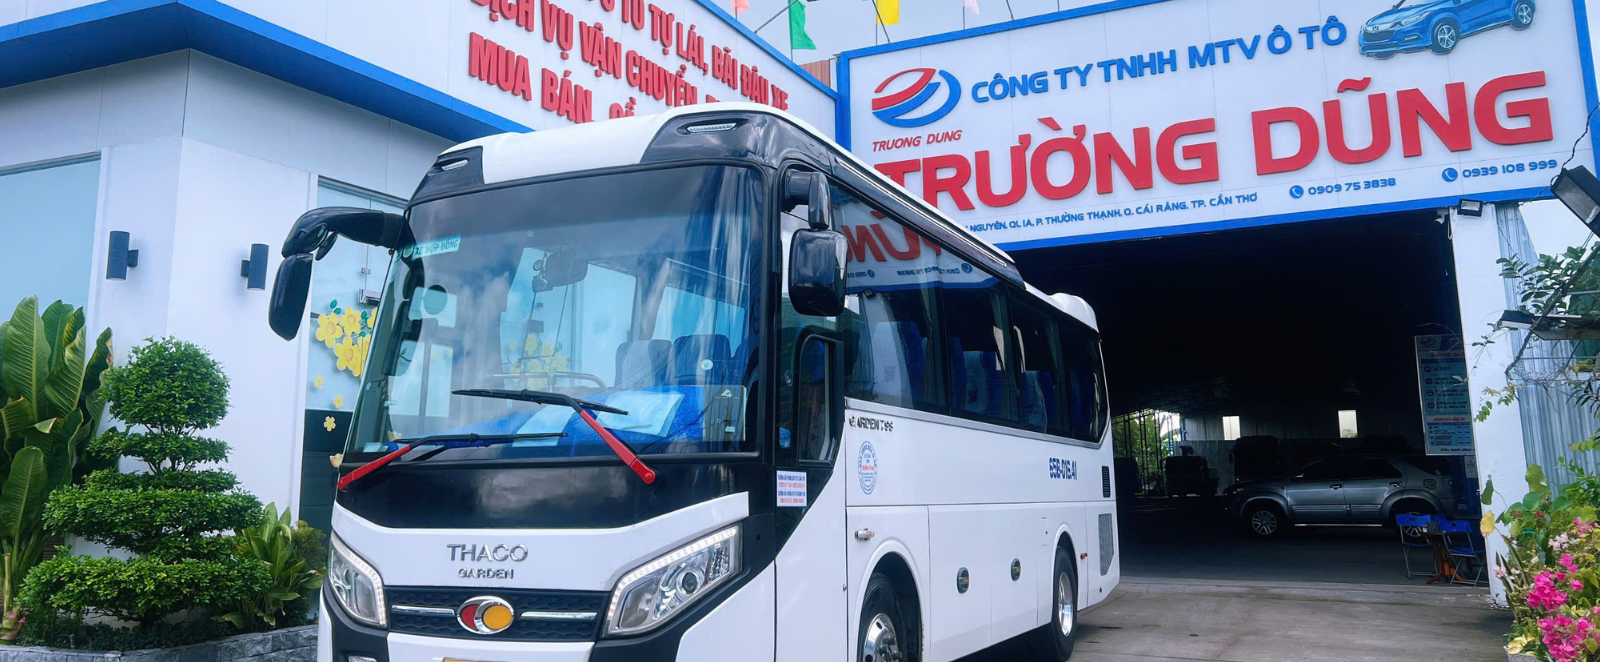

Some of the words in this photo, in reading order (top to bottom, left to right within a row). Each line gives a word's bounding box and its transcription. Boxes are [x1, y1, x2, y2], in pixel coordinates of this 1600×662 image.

[648, 4, 675, 55] TỰ
[468, 32, 532, 101] MUA
[541, 0, 574, 60] VỤ
[579, 22, 622, 79] VẬN
[626, 50, 698, 107] CHUYỂN
[971, 73, 1048, 102] CÔNG
[1054, 63, 1093, 89] TY
[1098, 49, 1177, 82] TNHH
[1188, 35, 1260, 69] MTV
[1267, 25, 1292, 54] Ô
[1298, 16, 1347, 49] TÔ
[872, 136, 921, 152] TRUONG
[926, 130, 962, 146] DUNG
[874, 116, 1220, 211] TRƯỜNG
[1251, 70, 1554, 175] DŨNG
[1462, 167, 1498, 178] 0939
[1502, 163, 1525, 174] 108
[1529, 159, 1558, 171] 999
[1308, 184, 1342, 195] 0909
[1345, 182, 1361, 191] 75
[1364, 178, 1396, 189] 3838
[1045, 212, 1084, 224] THƯỜNG
[1136, 203, 1153, 215] CÁI
[1191, 200, 1206, 209] TP.
[1209, 193, 1232, 206] CẦN
[1235, 192, 1257, 203] THƠ
[849, 415, 879, 430] GARDEN
[447, 543, 528, 562] THACO
[458, 567, 514, 579] GARDEN
